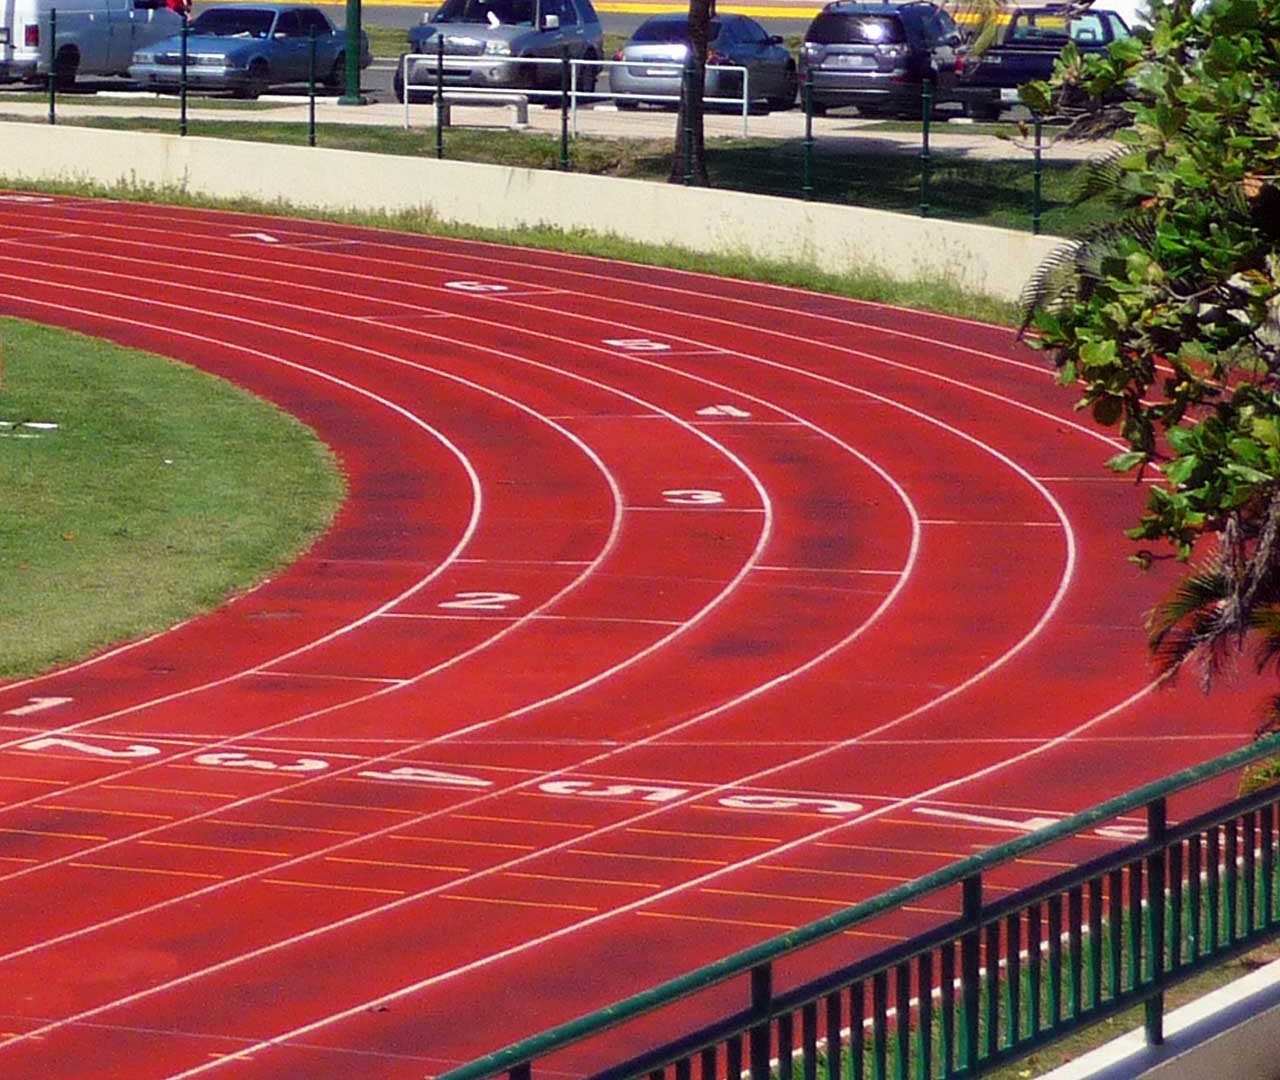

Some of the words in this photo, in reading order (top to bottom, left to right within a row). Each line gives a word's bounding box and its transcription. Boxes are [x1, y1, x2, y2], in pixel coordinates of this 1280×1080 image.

[229, 232, 279, 243] 7
[444, 280, 509, 292] 6
[602, 338, 671, 351] 5
[695, 404, 752, 419] 4
[661, 489, 726, 505] 3
[437, 591, 521, 610] 2
[4, 696, 74, 716] 1
[17, 737, 162, 758] 2
[193, 752, 330, 772] 3
[357, 766, 494, 787] 4
[538, 780, 690, 802] 5
[717, 795, 864, 814] 6
